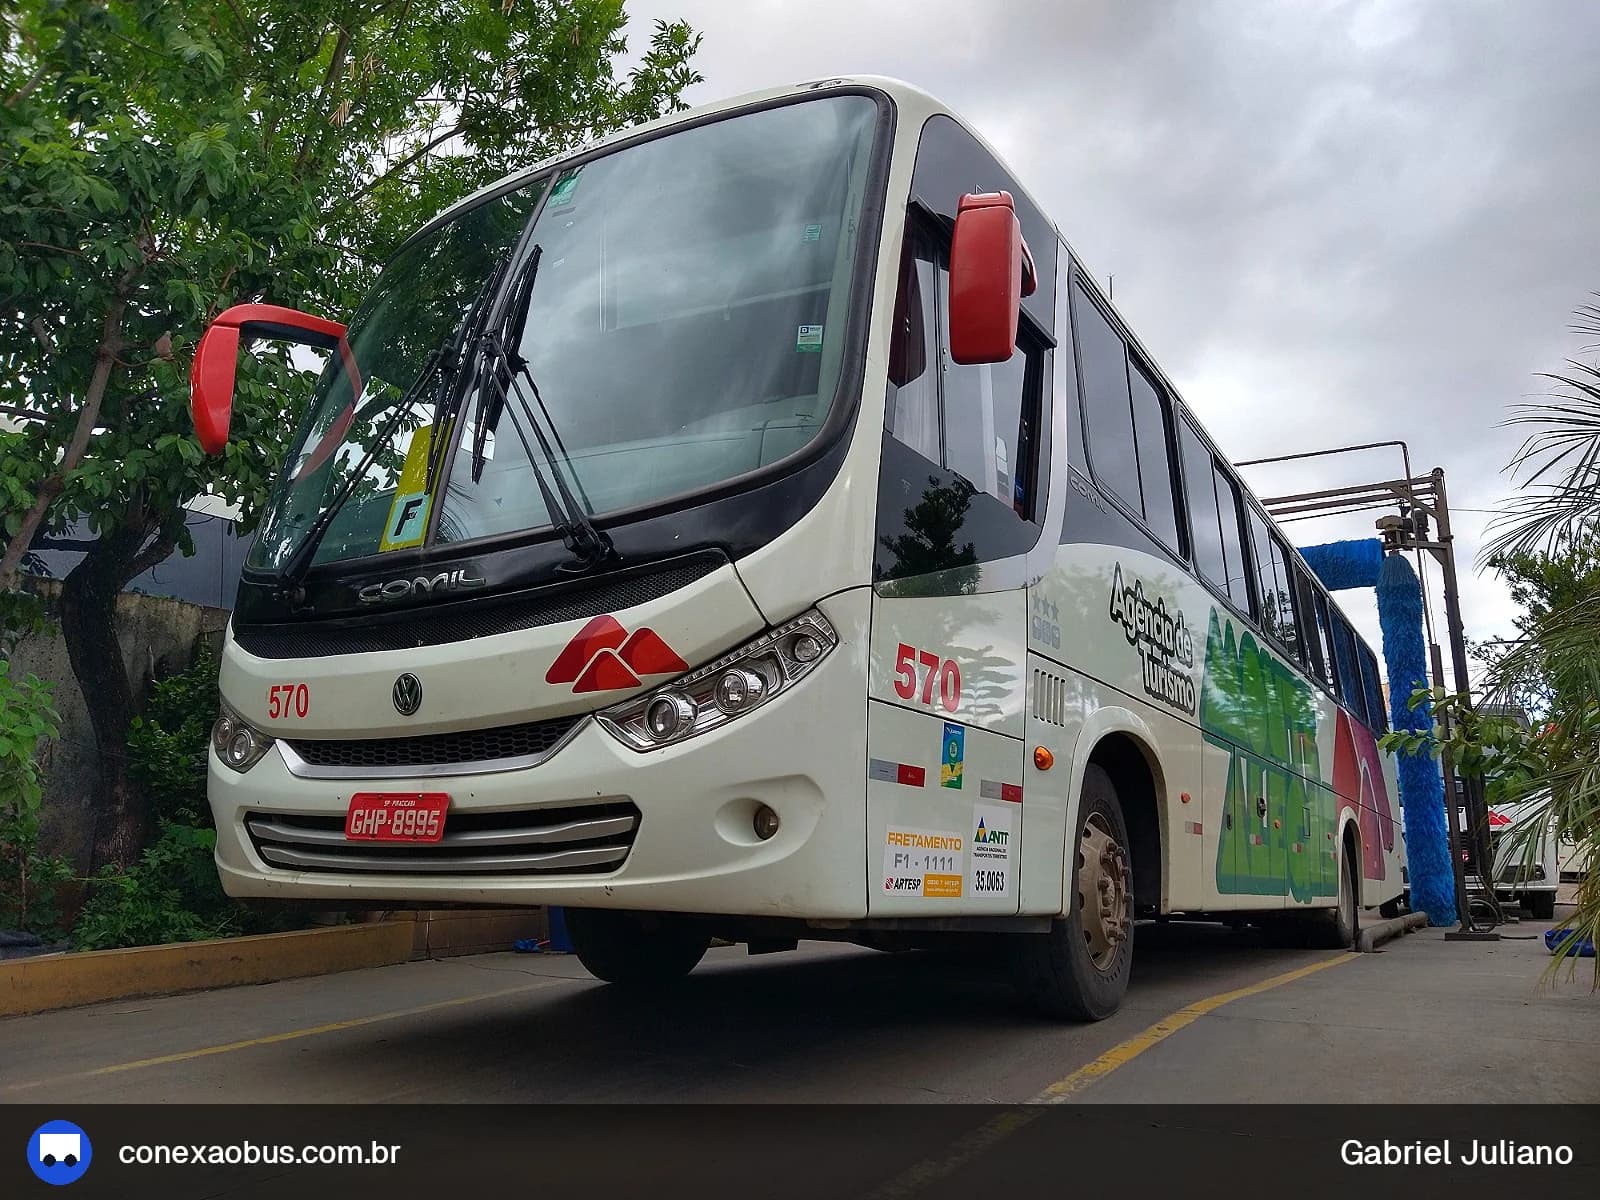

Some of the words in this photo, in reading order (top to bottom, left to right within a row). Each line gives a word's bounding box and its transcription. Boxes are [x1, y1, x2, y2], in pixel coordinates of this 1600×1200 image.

[358, 569, 487, 602] COMIL
[1110, 561, 1176, 658] Agência
[1175, 610, 1193, 669] de
[893, 642, 961, 713] 570
[1138, 640, 1196, 718] Turismo
[268, 683, 310, 719] 570
[350, 809, 441, 836] GHP-8995
[887, 831, 962, 851] FRETAMENTO
[894, 853, 910, 869] F1
[924, 855, 954, 871] 1111
[893, 877, 922, 891] ARTESP
[975, 870, 1005, 892] 35.0063
